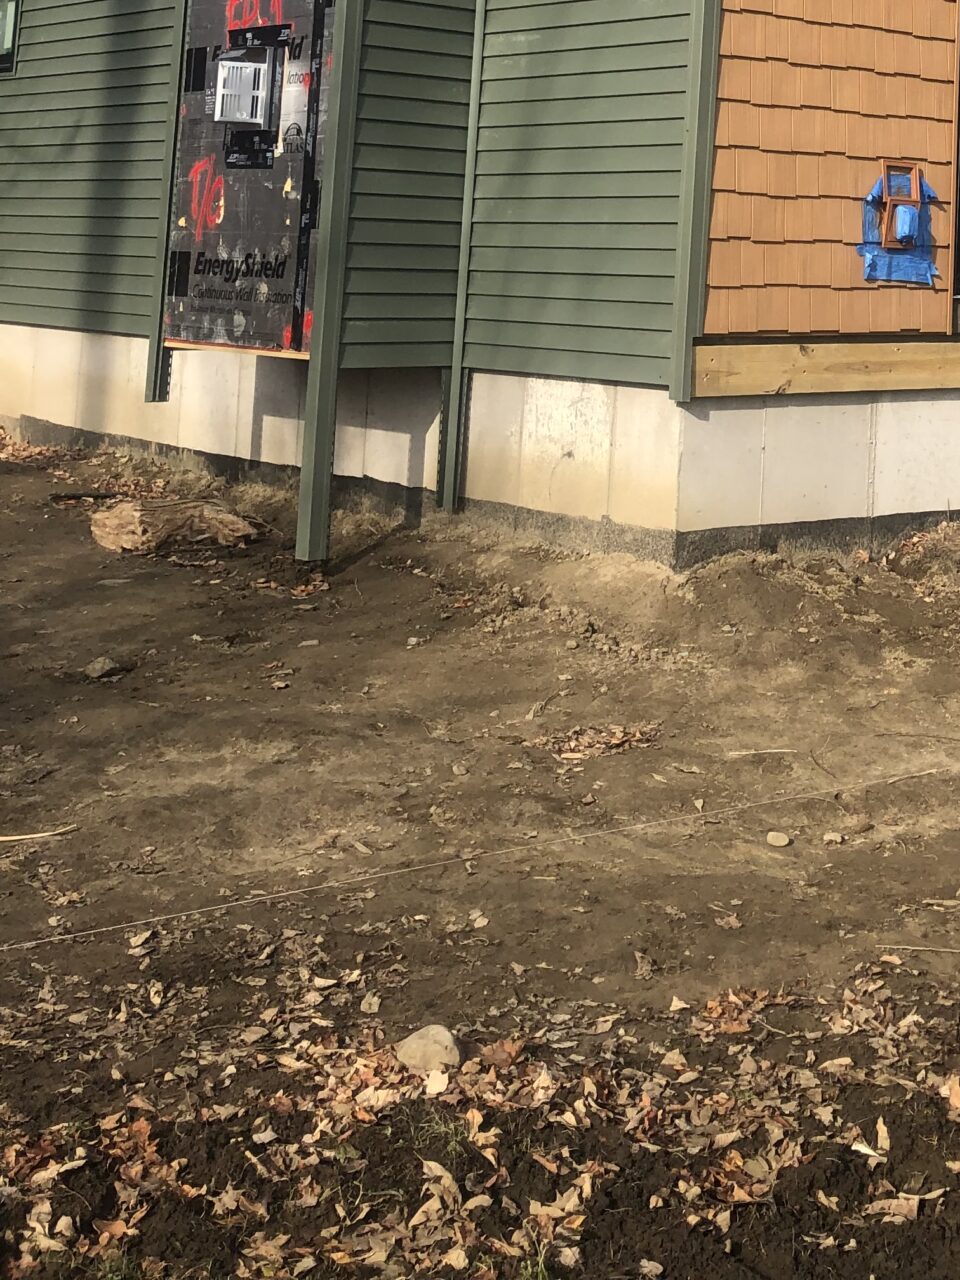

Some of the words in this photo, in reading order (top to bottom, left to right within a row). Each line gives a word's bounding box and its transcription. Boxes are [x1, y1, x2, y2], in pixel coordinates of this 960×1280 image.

[193, 250, 288, 283] EnergyShield
[192, 283, 234, 301] Continuous
[235, 287, 253, 301] Wall
